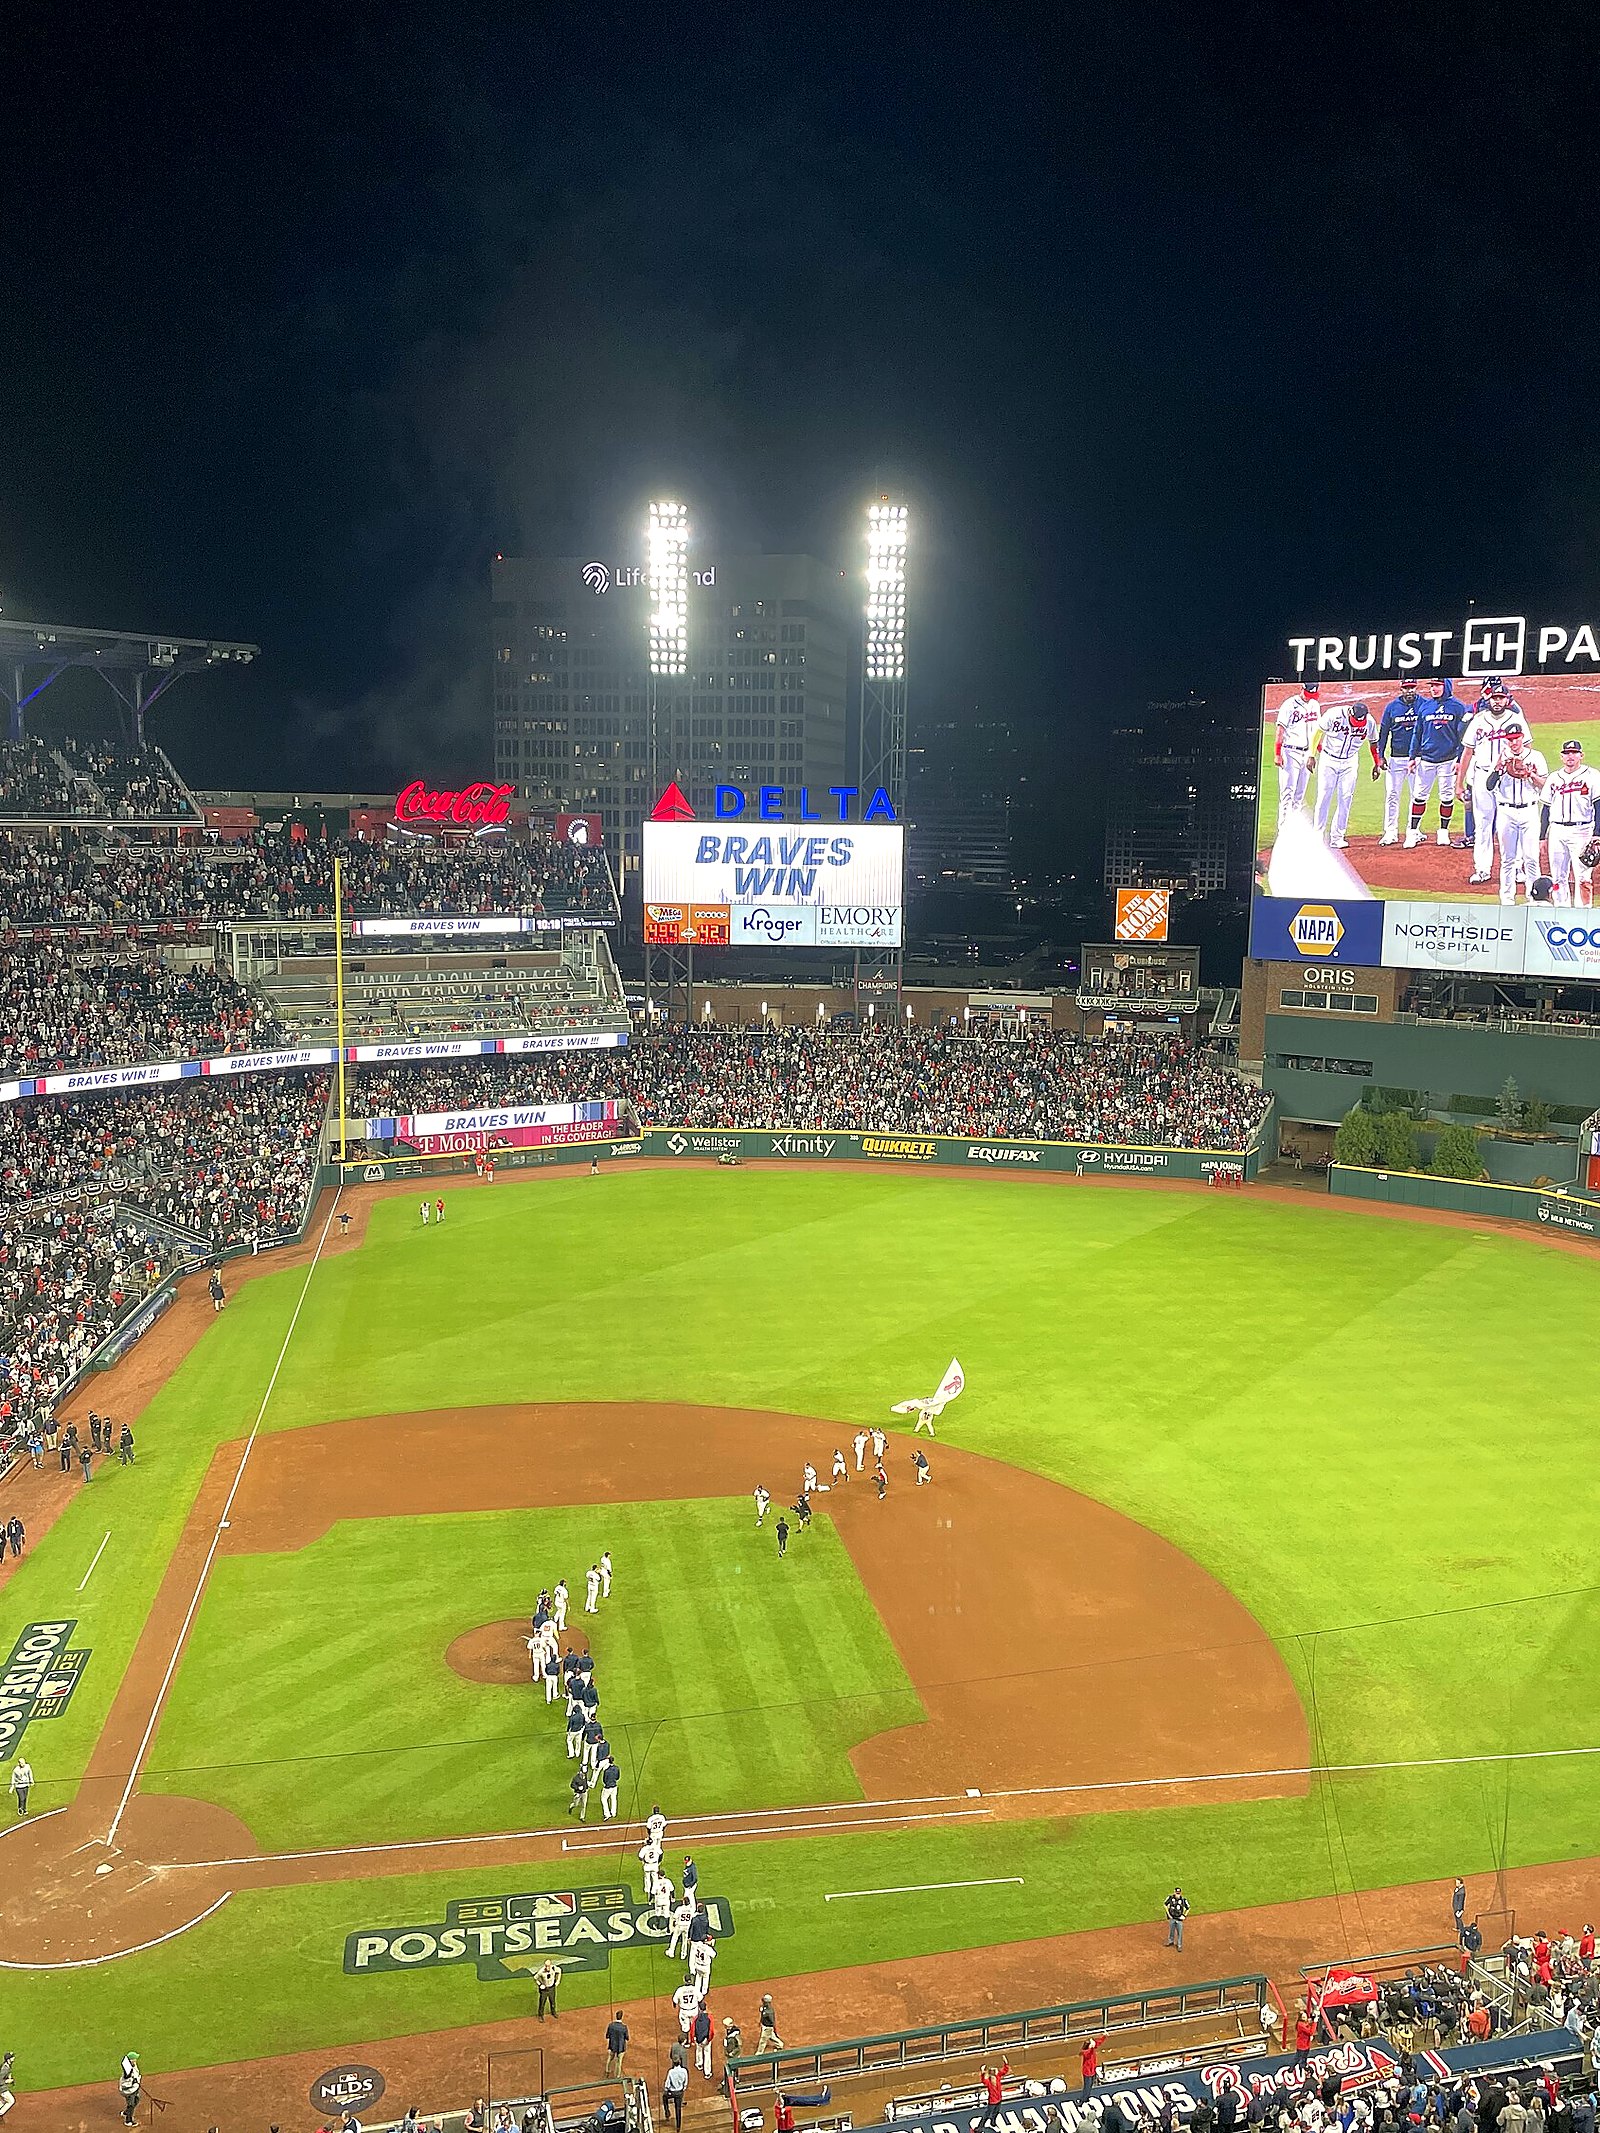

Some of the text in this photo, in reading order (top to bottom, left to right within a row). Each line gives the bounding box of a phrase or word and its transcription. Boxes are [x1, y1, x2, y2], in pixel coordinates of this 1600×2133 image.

[1288, 631, 1453, 672] TRUIST
[395, 780, 515, 823] Coca-Cola
[715, 784, 897, 821] DELTA
[695, 836, 855, 867] BRAVES
[734, 868, 817, 896] WIN
[1121, 894, 1145, 915] THE
[821, 908, 898, 925] EMORY
[1116, 889, 1168, 939] HOME
[216, 920, 232, 933] 42
[410, 921, 480, 931] BRAVES WIN
[648, 924, 679, 938] 494
[699, 924, 729, 938] 421
[743, 908, 802, 941] Kroger
[1135, 907, 1168, 939] DEPOT
[1298, 918, 1335, 941] NAPA
[820, 927, 894, 937] HEALTHCARE
[1395, 923, 1513, 941] NORTHSIDE
[1415, 940, 1490, 953] HOSPITAL
[1303, 967, 1355, 985] ORIS
[858, 981, 898, 990] CHAMPIONS
[376, 1044, 461, 1057] BRAVES WIN !!!
[522, 1036, 599, 1049] BRAVES WIN !!!
[230, 1052, 311, 1069] BRAVES WIN !!!
[68, 1068, 160, 1088] BRAVES WIN !!!
[445, 1111, 546, 1130] BRAVES WIN
[551, 1121, 603, 1134] THE LEADER
[438, 1132, 488, 1152] Mobil
[541, 1135, 551, 1144] IN
[553, 1134, 565, 1143] 5G
[691, 1136, 741, 1148] Wellstar
[771, 1134, 836, 1157] xfinity
[862, 1138, 937, 1155] QUIKRETE
[967, 1146, 1041, 1163] EQUIFAX
[1104, 1152, 1168, 1166] HYUNDAI
[1103, 1164, 1154, 1172] HyundaiUSA.com
[1564, 1217, 1594, 1232] NETWORK
[652, 1821, 662, 1830] 37
[649, 1851, 654, 1859] 2
[661, 1886, 667, 1894] 4
[580, 1892, 624, 1909] 22
[458, 1905, 502, 1920] 20
[681, 1913, 691, 1922] 59
[683, 1995, 694, 2004] 57
[321, 2078, 374, 2098] NLDS
